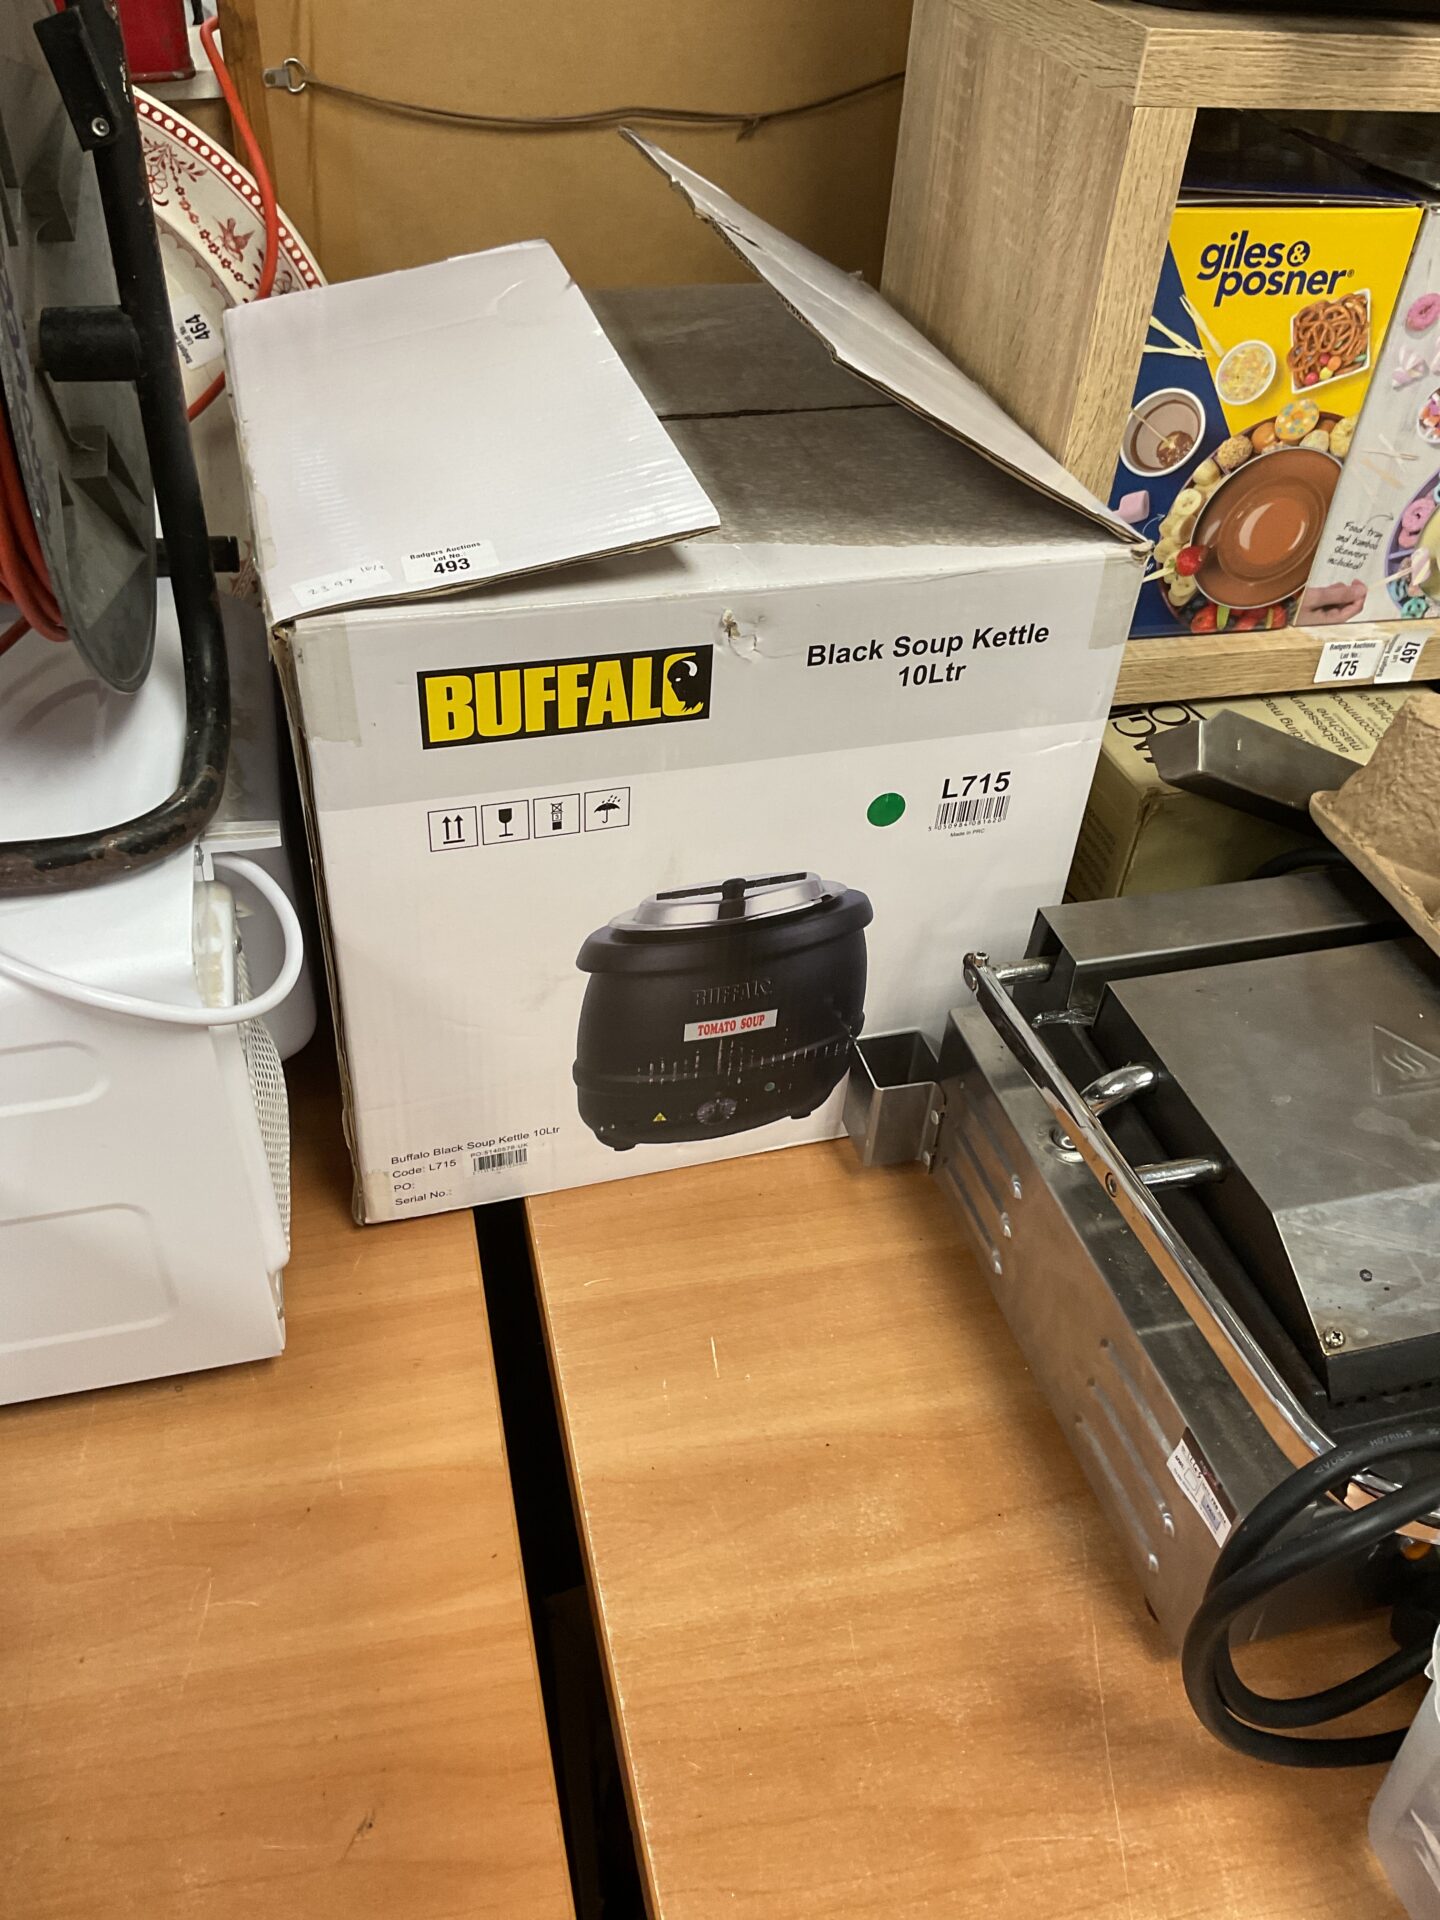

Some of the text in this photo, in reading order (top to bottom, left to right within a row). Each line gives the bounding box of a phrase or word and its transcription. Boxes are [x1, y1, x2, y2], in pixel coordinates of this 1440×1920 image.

[1197, 230, 1286, 281] giles
[185, 314, 211, 340] 464
[410, 542, 481, 560] Badgers Auctions
[434, 558, 470, 573] 493
[807, 623, 1050, 667] Black Soup Kettle
[1400, 642, 1420, 664] 497
[898, 662, 967, 687] 10Ltr
[1333, 660, 1359, 677] 475
[424, 652, 704, 743] BUFFALO
[1316, 707, 1363, 752] maschine
[941, 771, 1011, 799] L715
[697, 1014, 765, 1036] TOMATO SOUP
[391, 1126, 560, 1165] Buffalo Black Soup Kettle 10Ltr
[392, 1159, 457, 1178] Code: L715
[394, 1182, 415, 1192] PO:
[395, 1193, 426, 1206] Serial
